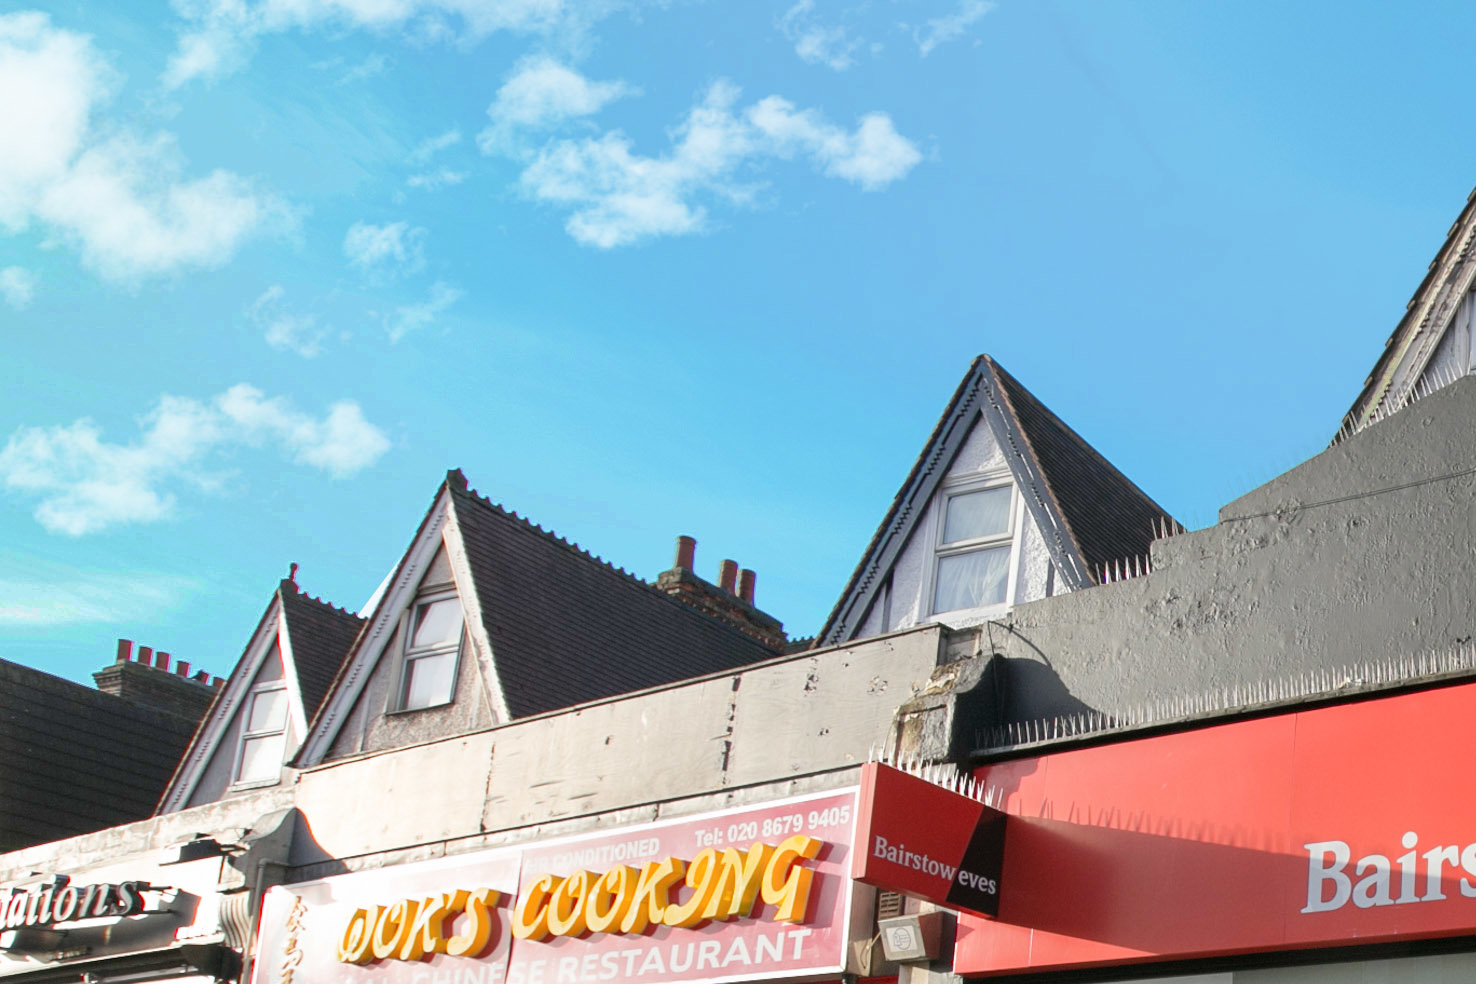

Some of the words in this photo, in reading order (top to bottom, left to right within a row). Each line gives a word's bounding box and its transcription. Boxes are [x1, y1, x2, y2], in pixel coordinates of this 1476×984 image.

[550, 837, 660, 870] CONDITIONED
[695, 829, 723, 849] Tel:
[727, 821, 756, 842] 020
[763, 813, 803, 838] 8679
[808, 805, 850, 830] 9405
[511, 834, 823, 941] COOKING
[873, 835, 957, 881] Bairstow
[958, 870, 996, 895] eves
[558, 928, 812, 984] RESTAURANT
